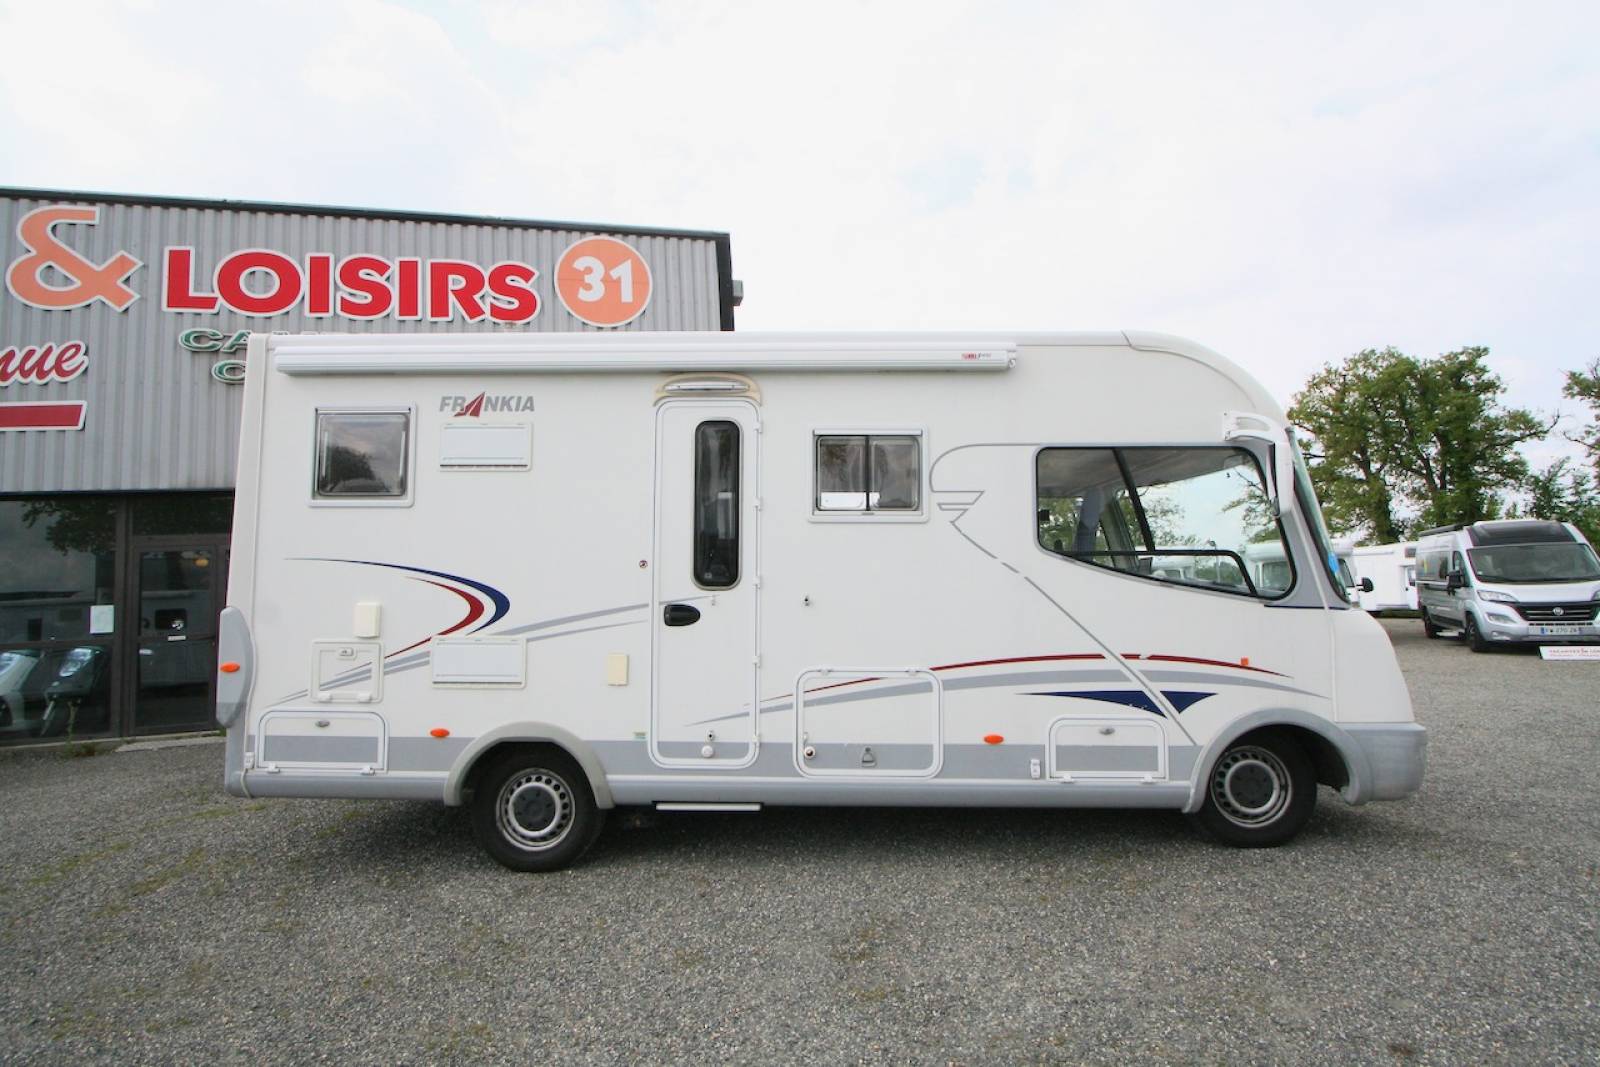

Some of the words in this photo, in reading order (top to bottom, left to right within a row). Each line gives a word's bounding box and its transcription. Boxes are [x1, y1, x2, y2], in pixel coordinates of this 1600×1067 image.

[6, 205, 143, 311] &
[163, 246, 540, 324] LOISIRS
[572, 255, 634, 304] 31
[440, 391, 535, 417] FRANKIA
